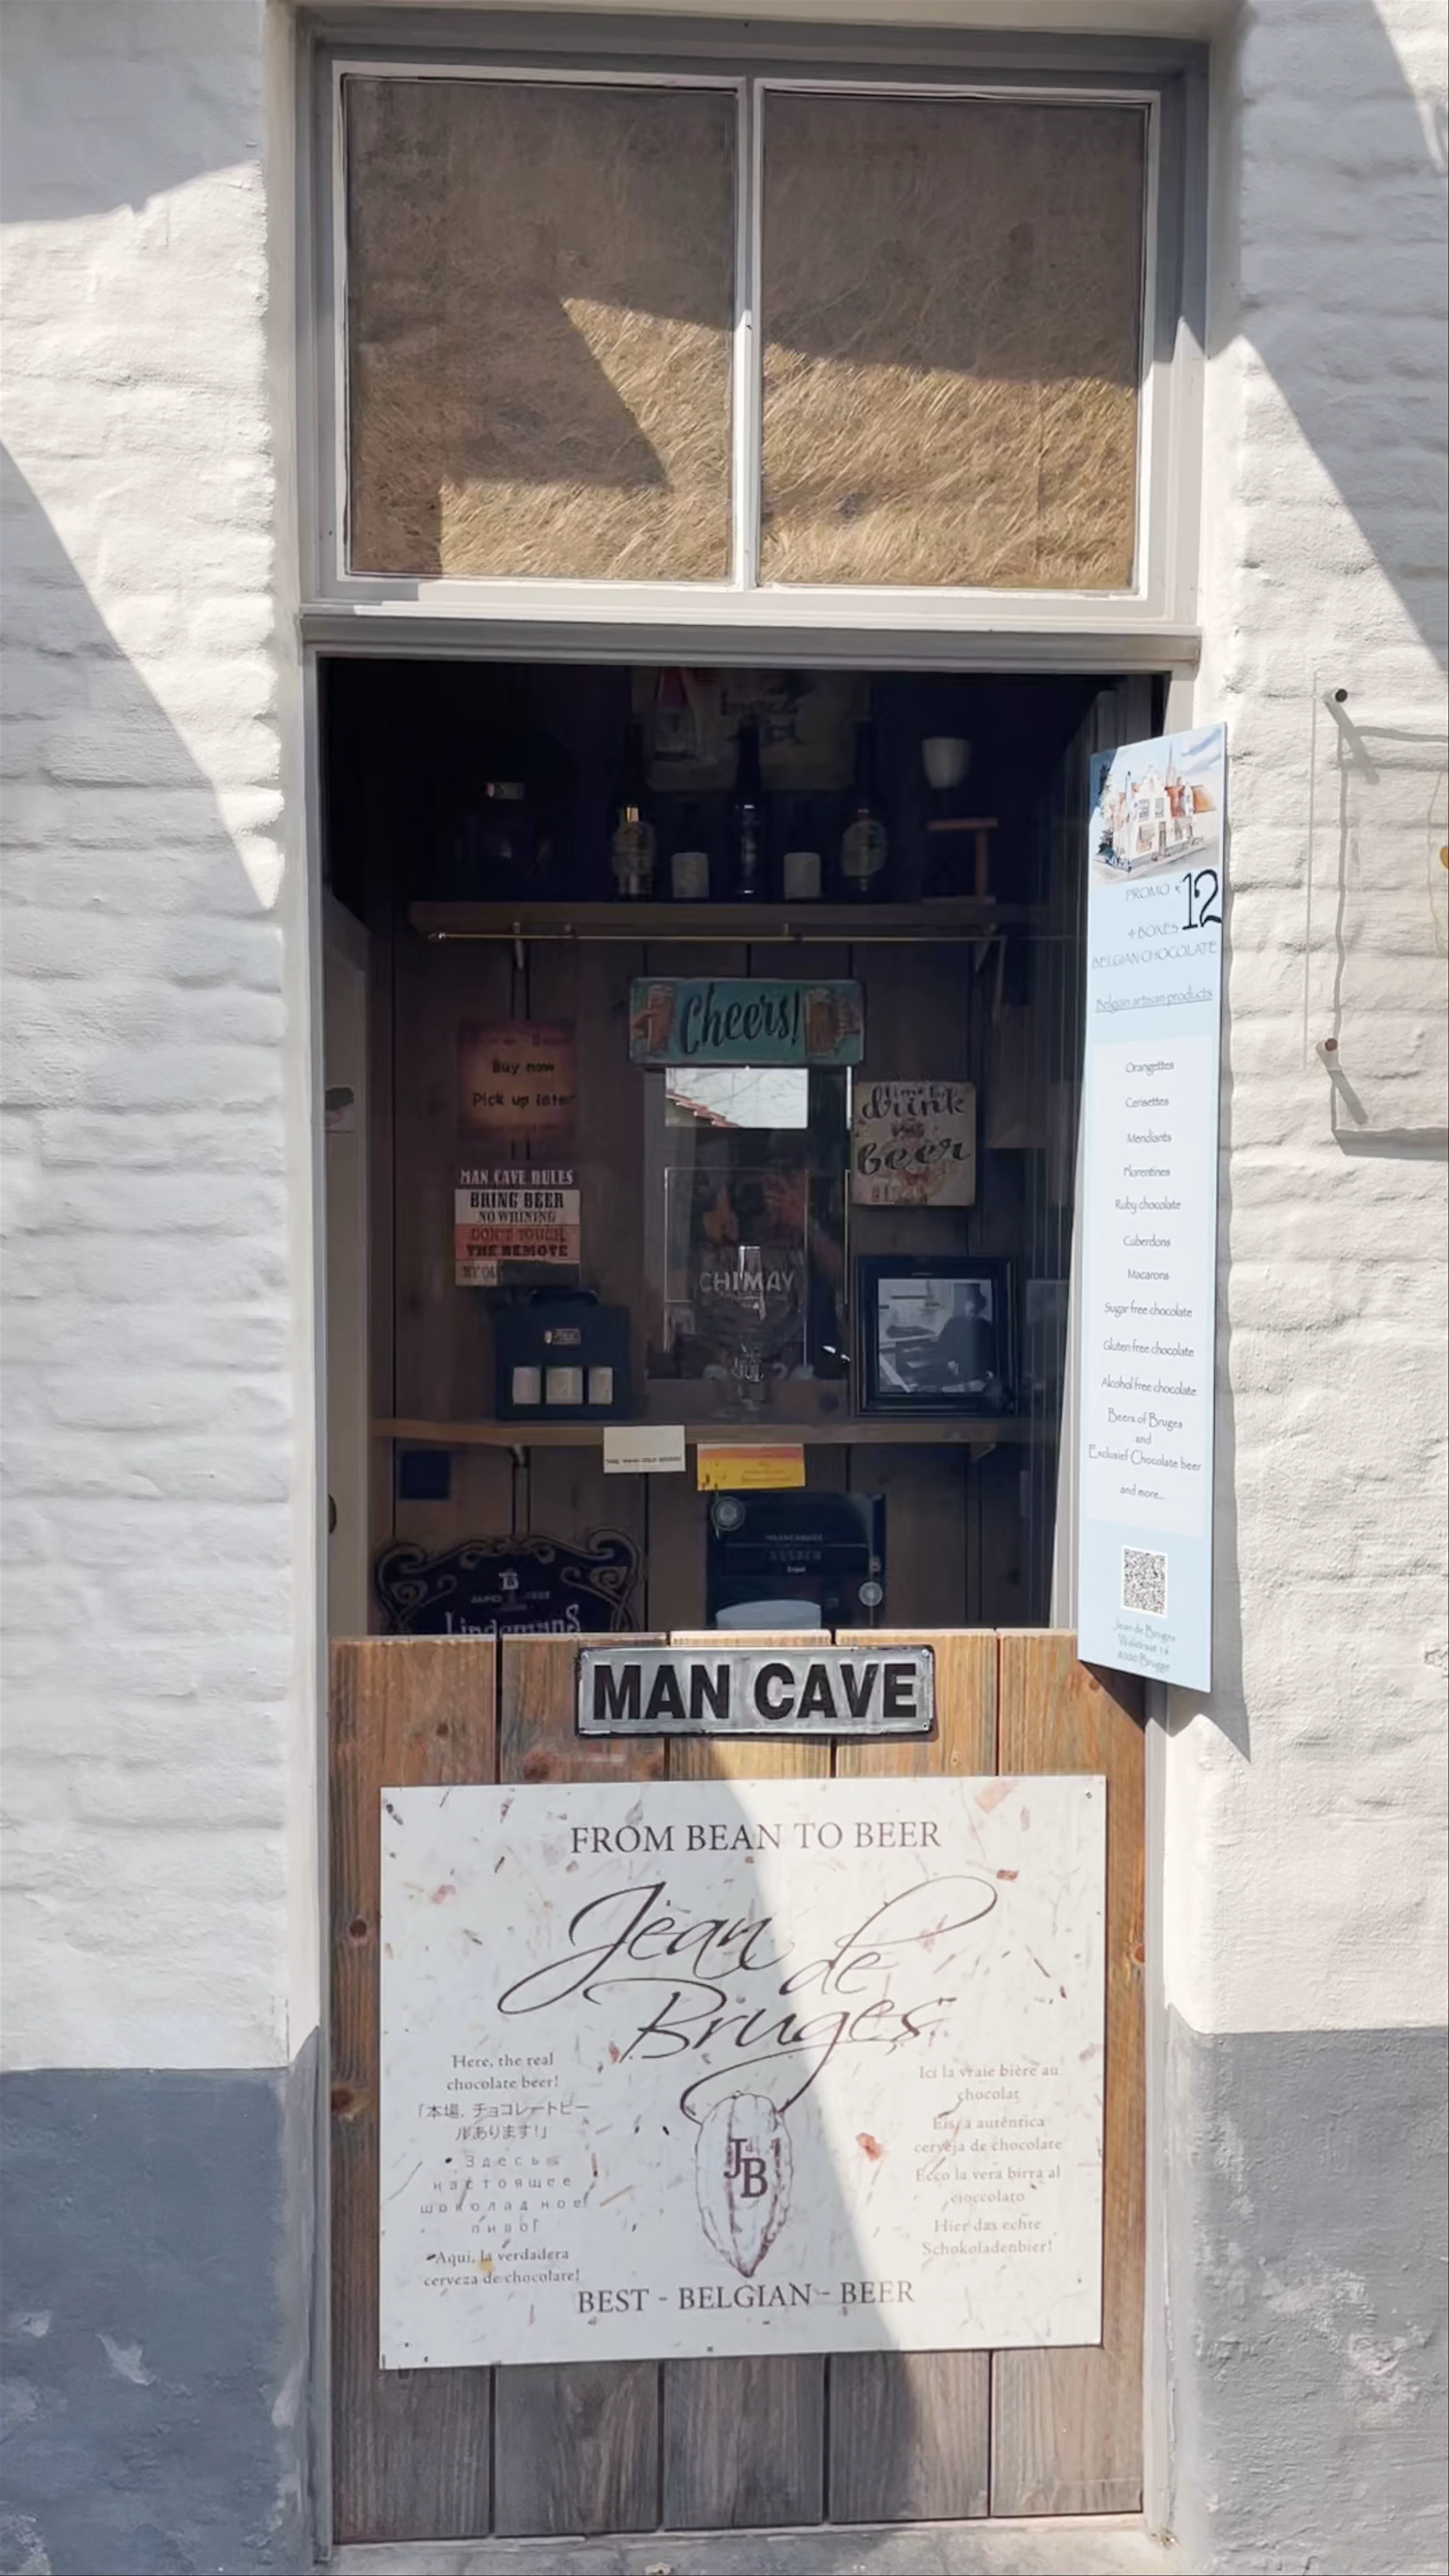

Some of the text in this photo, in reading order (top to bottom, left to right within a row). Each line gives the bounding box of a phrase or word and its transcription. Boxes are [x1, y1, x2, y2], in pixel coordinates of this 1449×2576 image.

[1126, 883, 1170, 901] PROMO
[1182, 869, 1223, 930] 12
[1137, 923, 1179, 939] BOXES
[1092, 941, 1217, 968] BELGIAN CHOCOLATE
[1096, 984, 1213, 1014] Belgian artisan products
[681, 982, 798, 1054] Cheers!
[492, 1058, 554, 1076] Buy now
[1125, 1061, 1174, 1076] Orangettes
[472, 1093, 504, 1106] Pick
[511, 1095, 529, 1110] up
[862, 1086, 965, 1119] drink
[1125, 1096, 1169, 1108] Cerisettes
[1126, 1129, 1172, 1143] Mendiants
[857, 1138, 971, 1175] beer
[460, 1169, 574, 1185] MAN CAVE RULES
[1123, 1164, 1171, 1177] Florentines
[471, 1192, 563, 1208] BRING BEER
[1115, 1196, 1181, 1215] Ruby chocolate
[479, 1210, 556, 1223] NO WHINING
[1123, 1233, 1171, 1247] Cuberdons
[467, 1245, 568, 1256] THE REMOTE
[699, 1270, 794, 1292] CHIMAY
[1127, 1268, 1170, 1280] Macarons
[1104, 1300, 1193, 1318] Sugar free chocolate
[1103, 1337, 1194, 1357] Gluten free chocolate
[1101, 1374, 1197, 1396] Alcohol free chocolate
[1108, 1407, 1183, 1432] Beers of Bruges
[1135, 1432, 1152, 1445] and
[1089, 1444, 1202, 1471] Exclusief Chocolate beer
[1120, 1483, 1136, 1495] and
[592, 1662, 917, 1720] MAN CAVE
[571, 1821, 942, 1853] FROM BEAN TO BEER
[779, 1875, 998, 1995] de
[498, 1882, 794, 2015] Jean
[451, 2051, 554, 2068] Here, the real
[584, 1978, 957, 2124] Bruges
[919, 2063, 1059, 2079] Ici la vraie bière au
[446, 2075, 558, 2092] chocolate beer!
[957, 2086, 1020, 2101] chocolat
[964, 2119, 972, 2129] a
[976, 2114, 1046, 2129] autêntica
[914, 2136, 1063, 2156] cerveja de chocolate
[916, 2164, 1060, 2182] Ecco la vera birra al
[950, 2189, 1025, 2204] cioccolato
[934, 2216, 1041, 2232] Hier das echte
[480, 2249, 492, 2263] la
[497, 2247, 569, 2262] verdadera
[921, 2238, 1052, 2255] Schokoladenbier!
[424, 2268, 580, 2287] cerveza de chocolate!
[578, 2288, 649, 2314] BEST
[678, 2284, 811, 2311] BELGIAN
[841, 2280, 914, 2304] BEER
